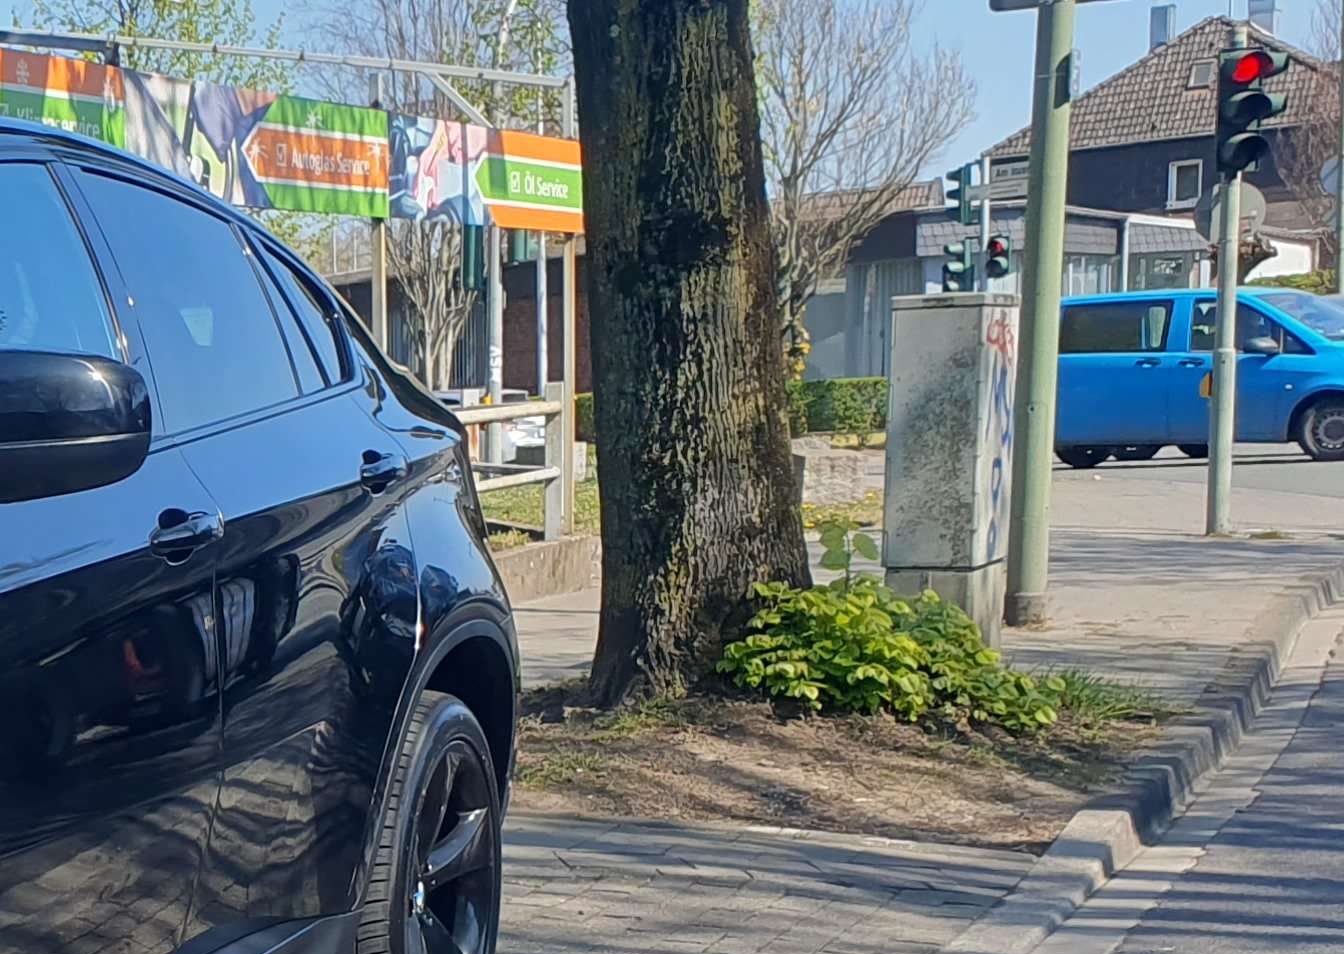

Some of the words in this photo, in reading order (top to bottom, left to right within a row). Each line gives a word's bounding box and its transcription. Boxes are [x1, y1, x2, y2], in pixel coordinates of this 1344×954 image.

[291, 147, 335, 177] Autoglas
[336, 151, 370, 176] Service
[524, 170, 535, 195] Öl
[536, 176, 569, 199] Service
